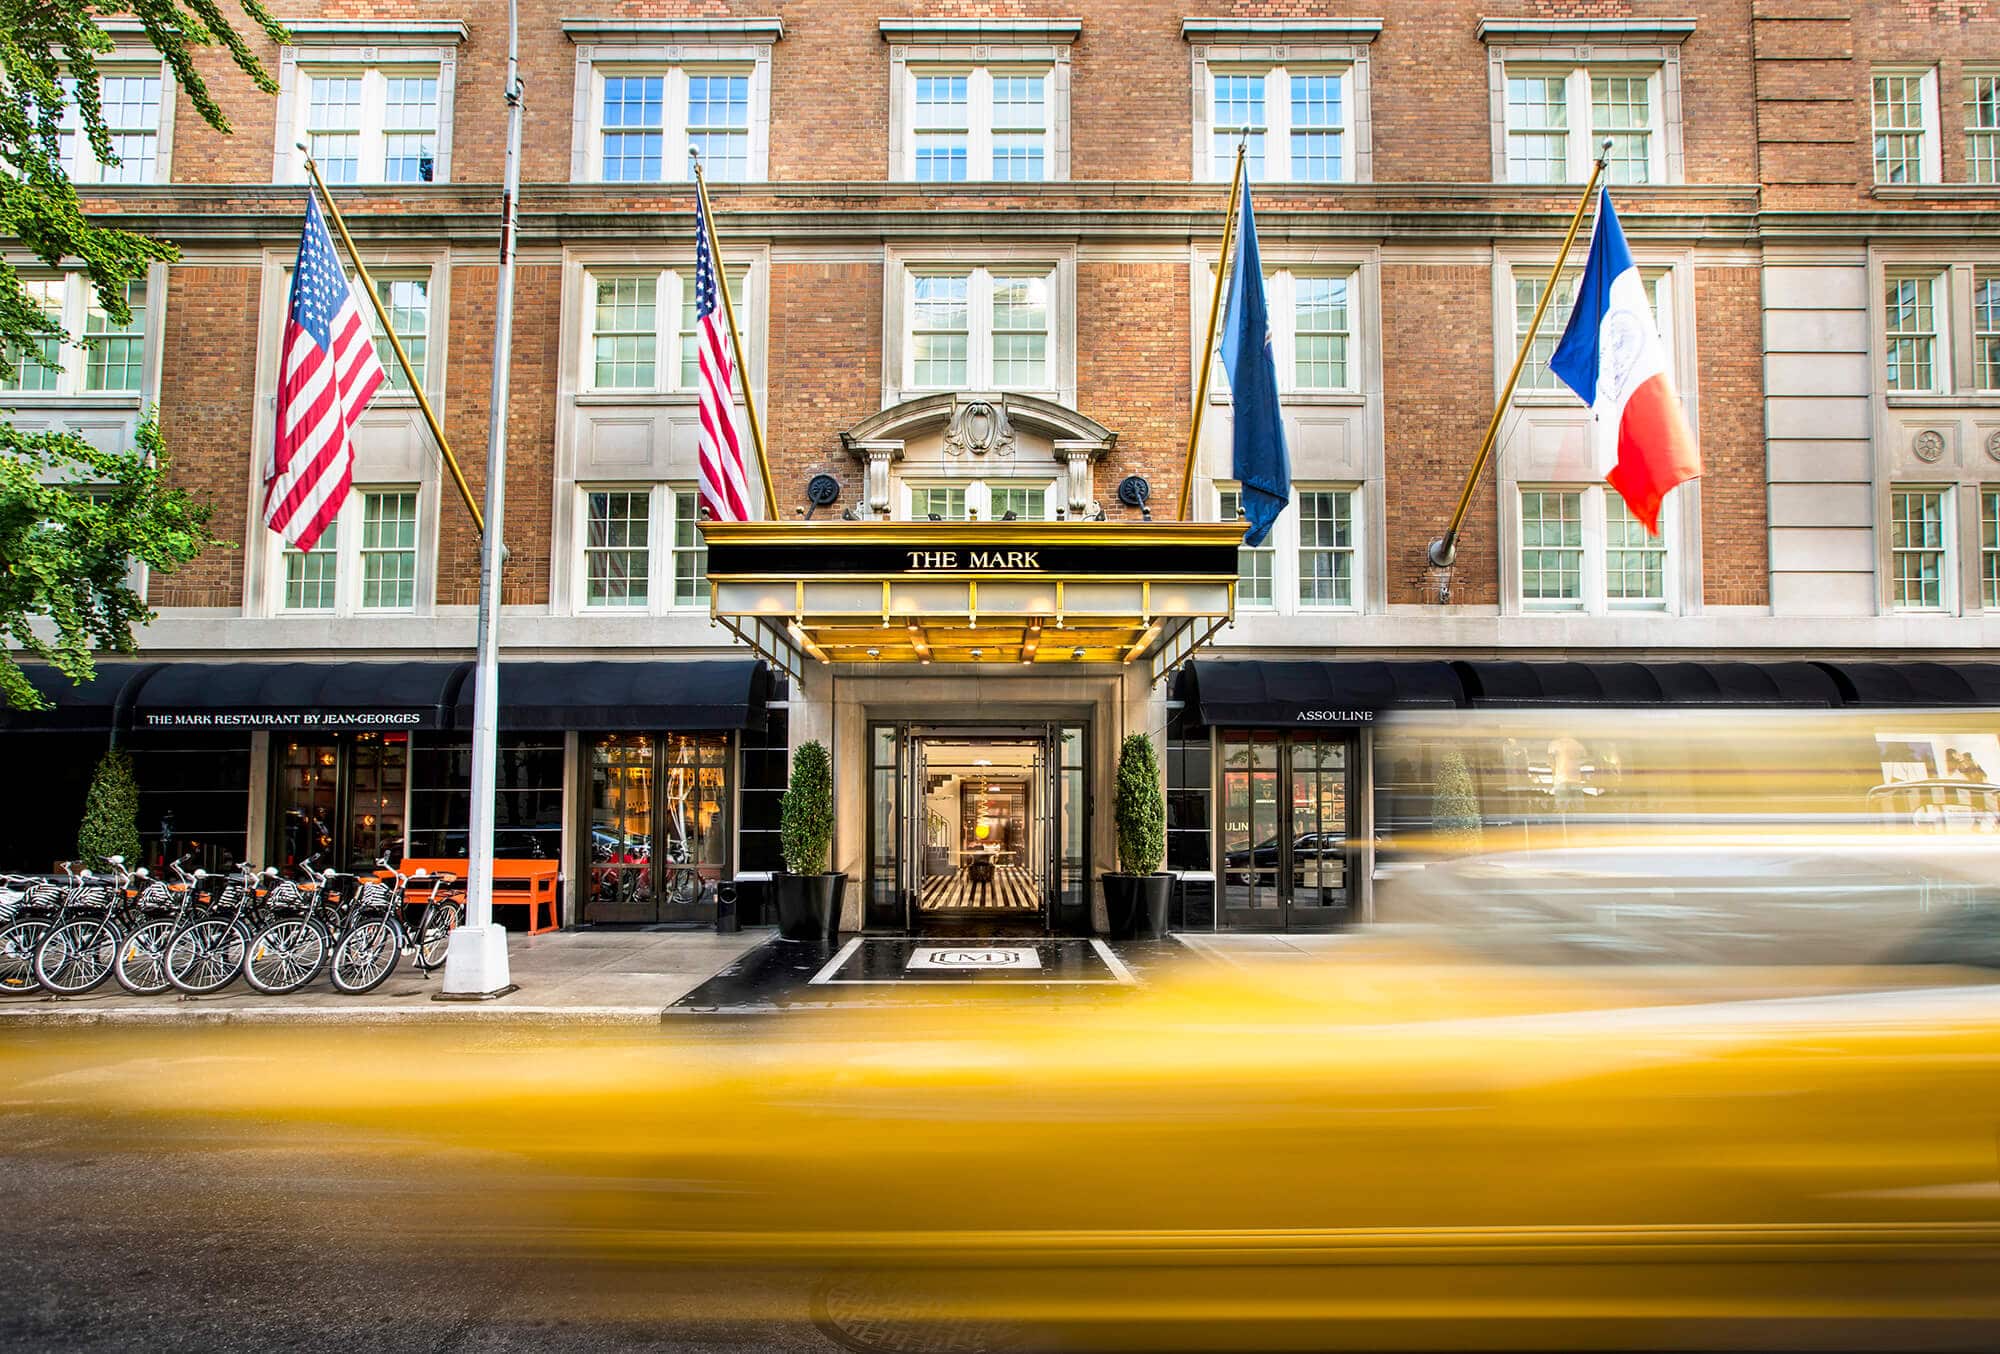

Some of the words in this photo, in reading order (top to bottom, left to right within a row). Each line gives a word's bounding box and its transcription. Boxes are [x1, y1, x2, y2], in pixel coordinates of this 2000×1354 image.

[906, 551, 958, 568] THE
[969, 551, 1041, 568] MARK
[146, 714, 173, 724] THE
[175, 714, 212, 724] MARK
[214, 714, 301, 724] RESTAURANT
[303, 714, 322, 724] BY
[322, 713, 421, 724] JEAN-GEORGES
[1296, 711, 1374, 721] ASSOULINE
